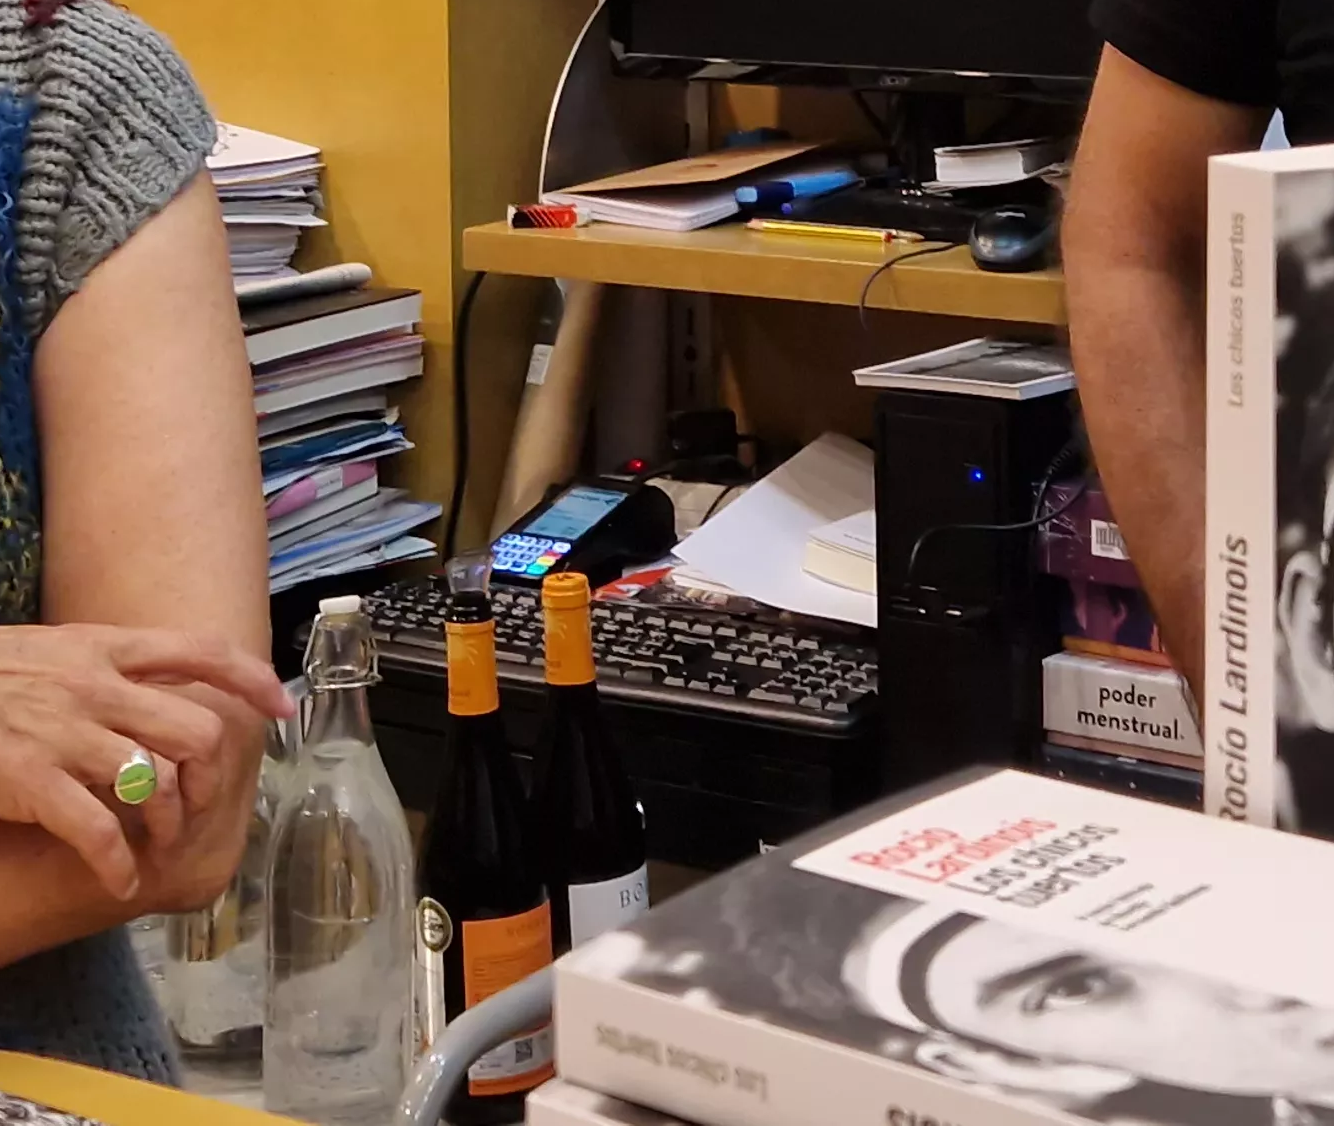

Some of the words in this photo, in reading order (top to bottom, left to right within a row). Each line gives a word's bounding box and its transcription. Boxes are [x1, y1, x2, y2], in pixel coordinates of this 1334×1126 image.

[1228, 210, 1248, 294] tuertos
[1227, 297, 1247, 368] chicos
[1227, 371, 1247, 409] Los
[1219, 533, 1251, 717] Lardinois
[1098, 683, 1157, 709] poder
[1218, 724, 1250, 823] Rocío
[849, 825, 963, 871] Rocío
[895, 817, 1058, 883] Lardinois
[1010, 822, 1121, 869] chicos
